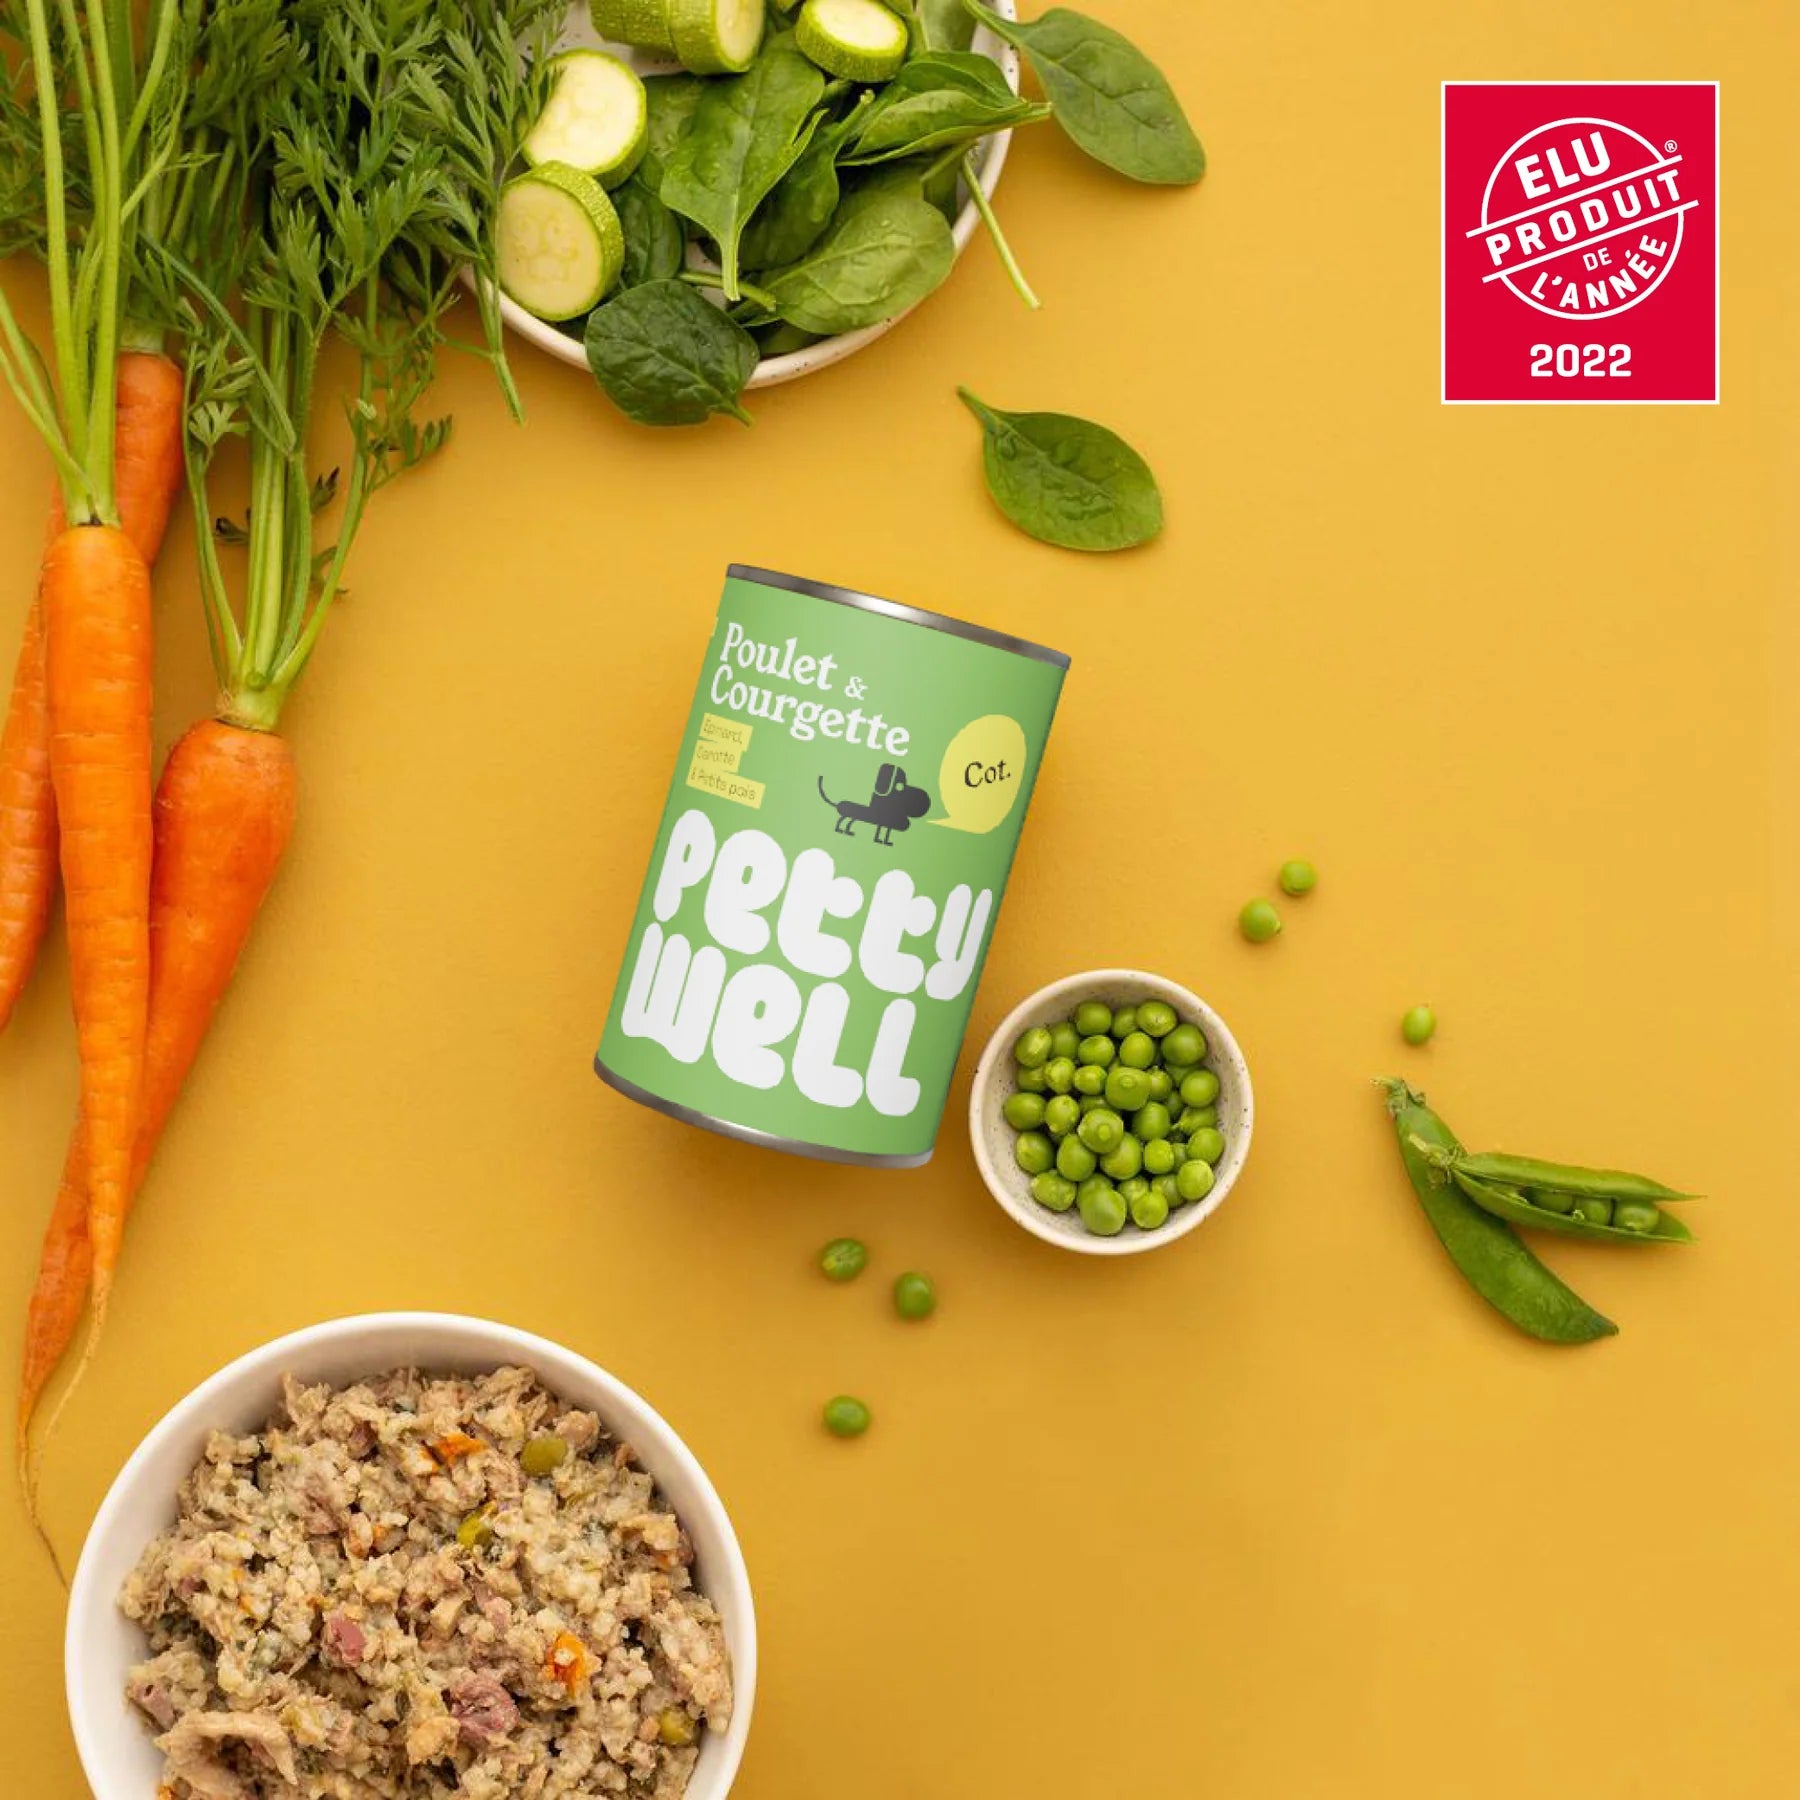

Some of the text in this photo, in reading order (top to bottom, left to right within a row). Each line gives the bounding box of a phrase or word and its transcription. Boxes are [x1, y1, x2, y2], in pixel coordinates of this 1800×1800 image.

[719, 622, 868, 700] Poulet &
[710, 664, 910, 757] Courgette
[963, 759, 1012, 788] Cot.
